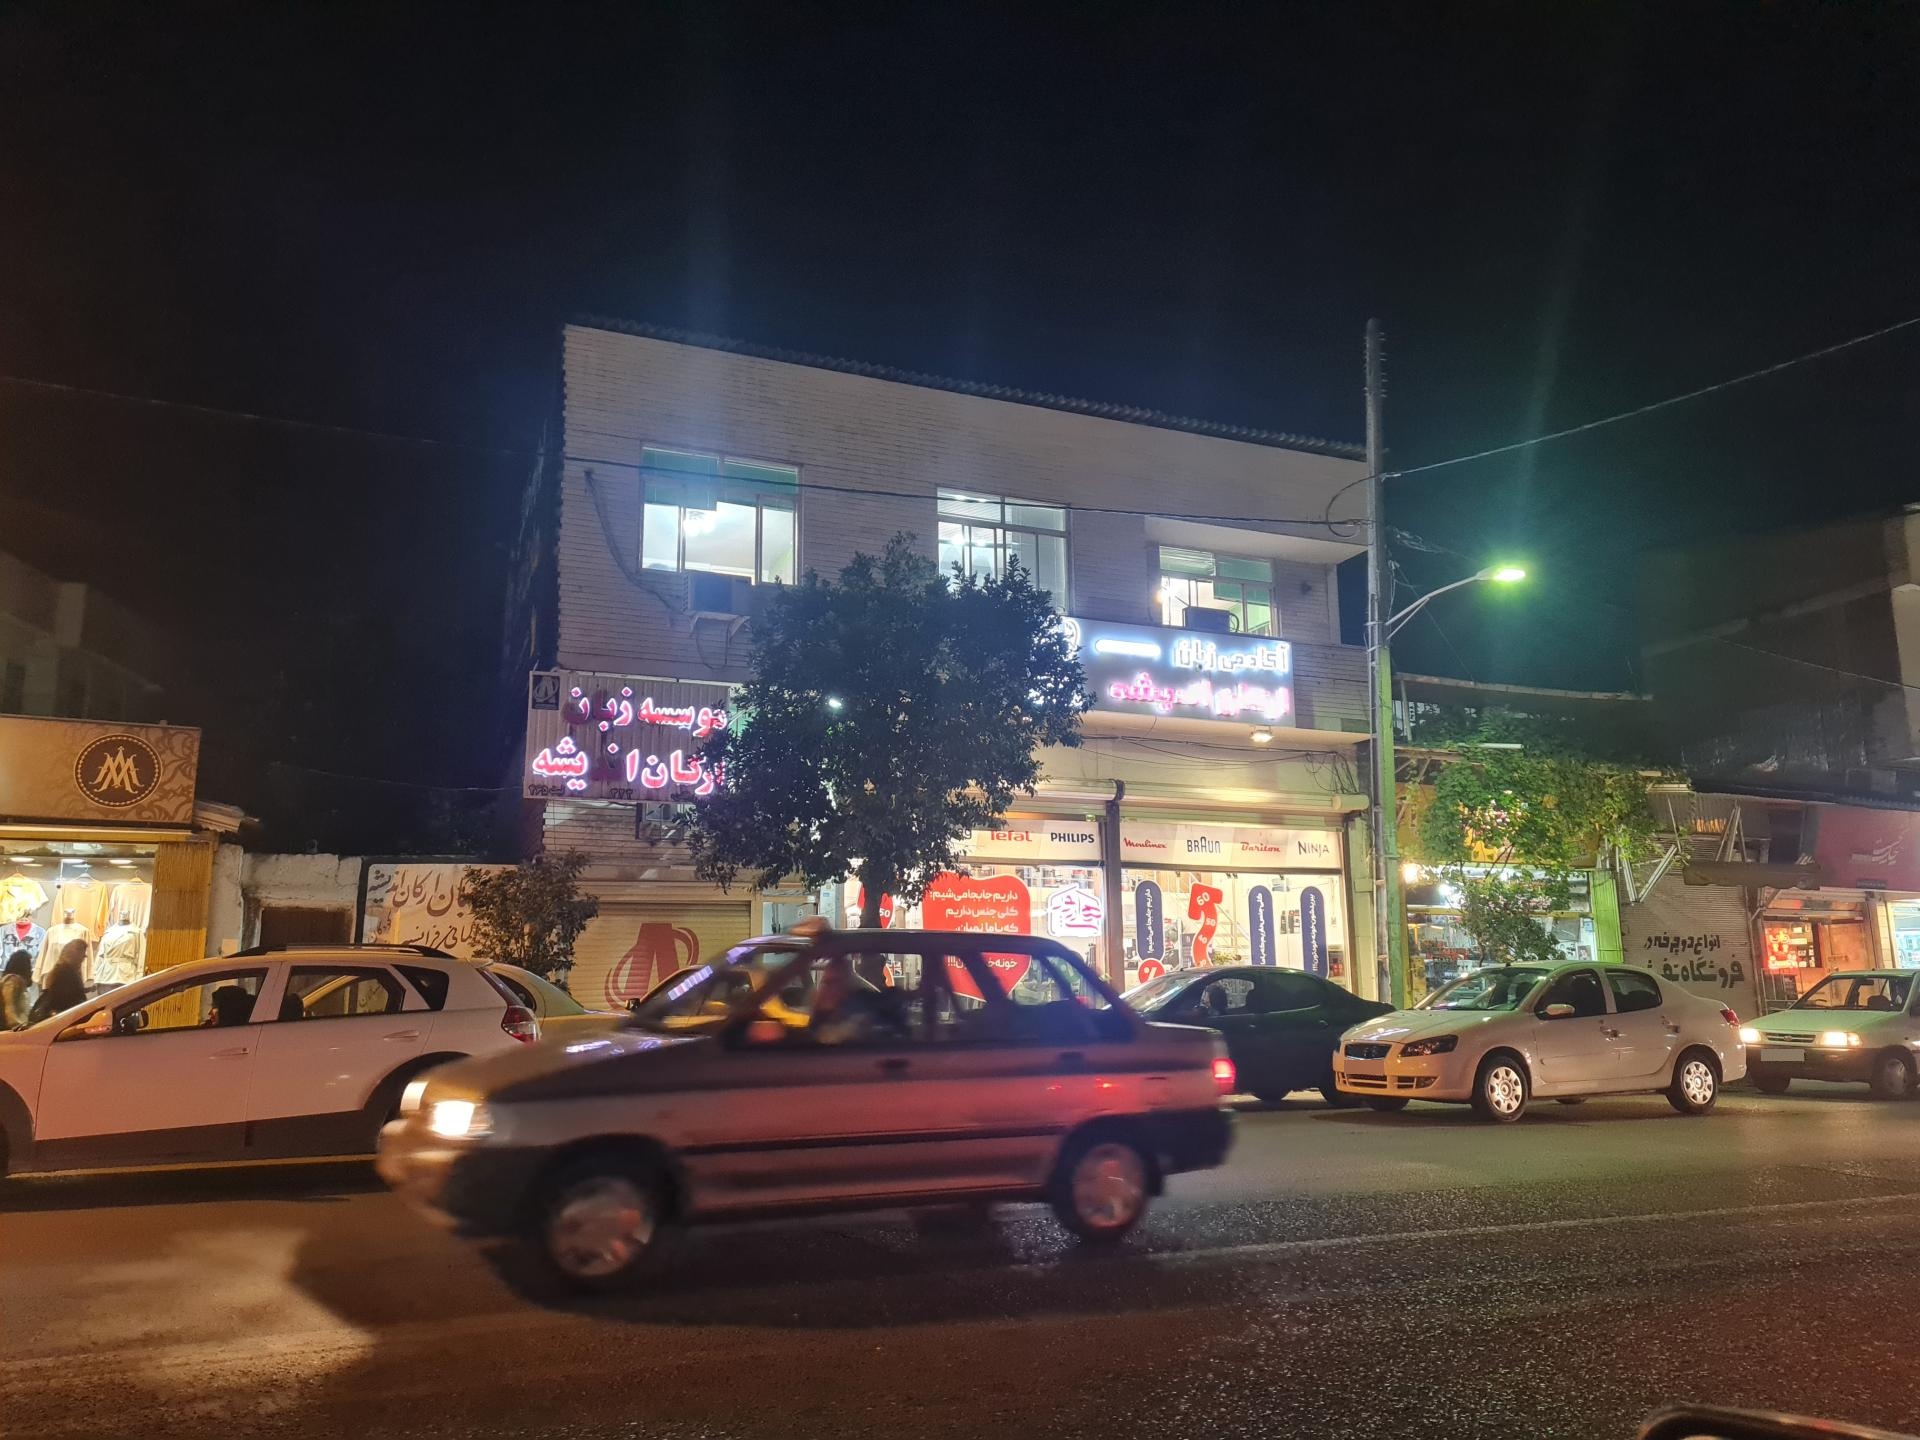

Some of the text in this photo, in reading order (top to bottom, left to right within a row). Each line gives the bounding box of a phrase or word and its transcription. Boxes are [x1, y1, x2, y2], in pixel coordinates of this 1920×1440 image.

[562, 686, 633, 732] زبان
[532, 736, 638, 791] اندیشه
[1051, 832, 1095, 843] PHILIPS
[1124, 837, 1168, 849] Moulinex
[1187, 836, 1221, 853] BRAUN
[1298, 840, 1330, 858] NINJA
[968, 889, 993, 902] جابجا
[993, 890, 1019, 903] داریم
[1196, 892, 1210, 906] 60
[945, 905, 1019, 919] کلی جنس داریم
[1694, 934, 1721, 956] انواع
[995, 957, 1018, 970] خونه
[1681, 953, 1745, 989] فروشگاه
